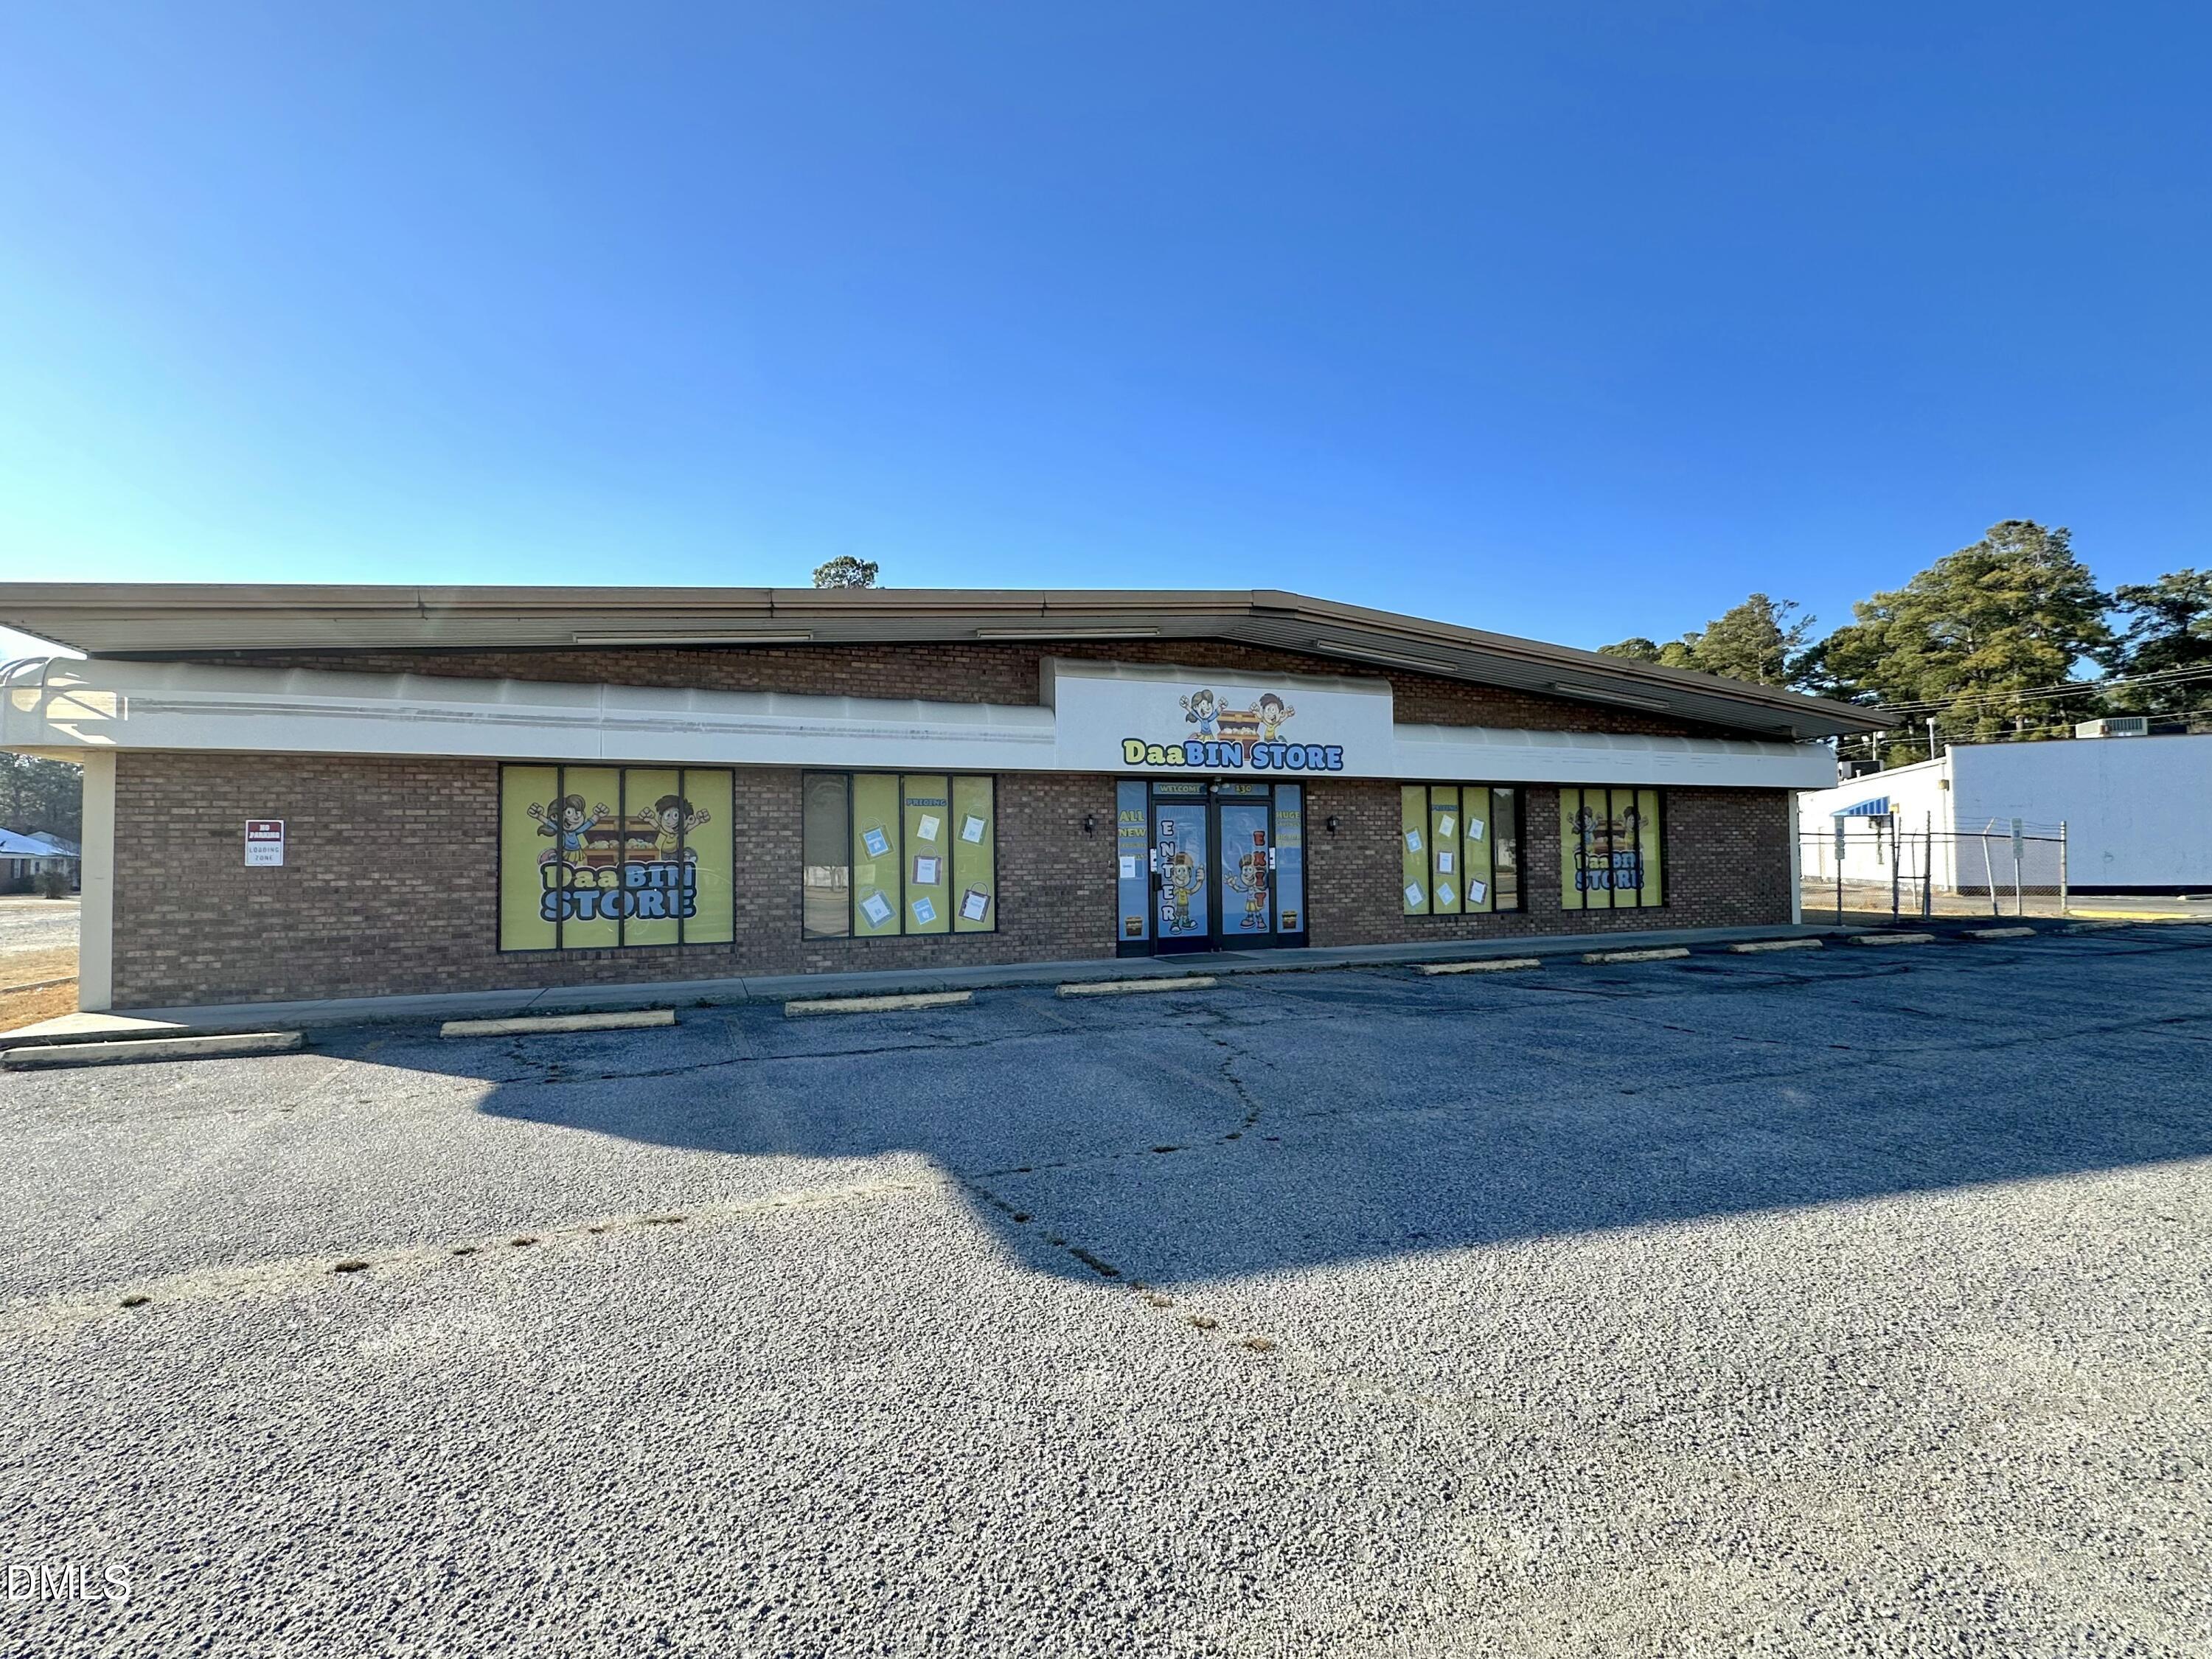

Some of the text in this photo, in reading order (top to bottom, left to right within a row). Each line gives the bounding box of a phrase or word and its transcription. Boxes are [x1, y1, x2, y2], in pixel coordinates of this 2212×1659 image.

[1122, 738, 1343, 771] DaaBIN STORE
[1159, 784, 1201, 793] WELCOME
[1234, 785, 1253, 794] 130
[1119, 810, 1145, 821] ALL
[1276, 811, 1301, 819] HUGE
[1118, 828, 1146, 838] NEW
[541, 862, 696, 889] DaaBIN
[1159, 820, 1176, 922] ENTER
[1253, 830, 1267, 908] EXIT
[1575, 869, 1644, 891] STORE
[541, 888, 697, 921] STORE
